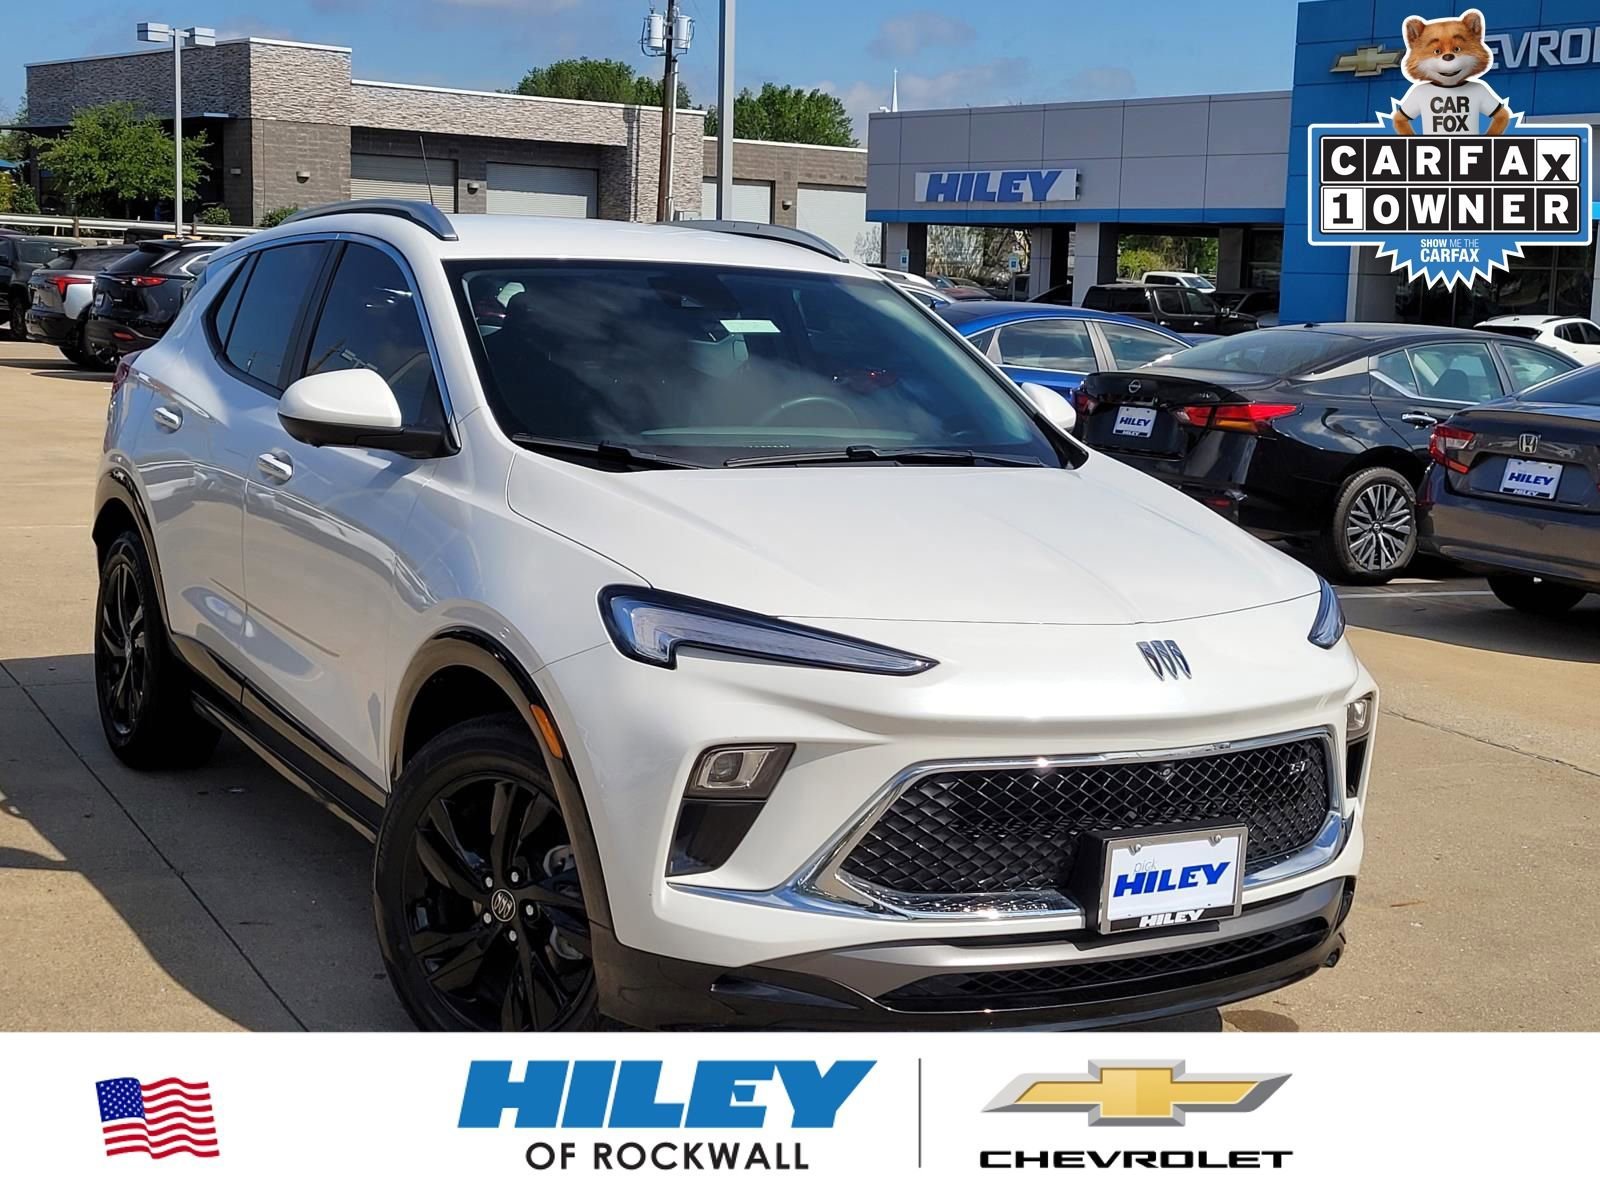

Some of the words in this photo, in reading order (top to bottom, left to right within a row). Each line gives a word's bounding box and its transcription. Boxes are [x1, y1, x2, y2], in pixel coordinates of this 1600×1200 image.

[926, 170, 1061, 202] HILEY
[1119, 416, 1151, 427] HILEY
[1508, 472, 1554, 486] HILEY
[1113, 862, 1231, 898] HILEY
[1139, 908, 1204, 928] HILEY
